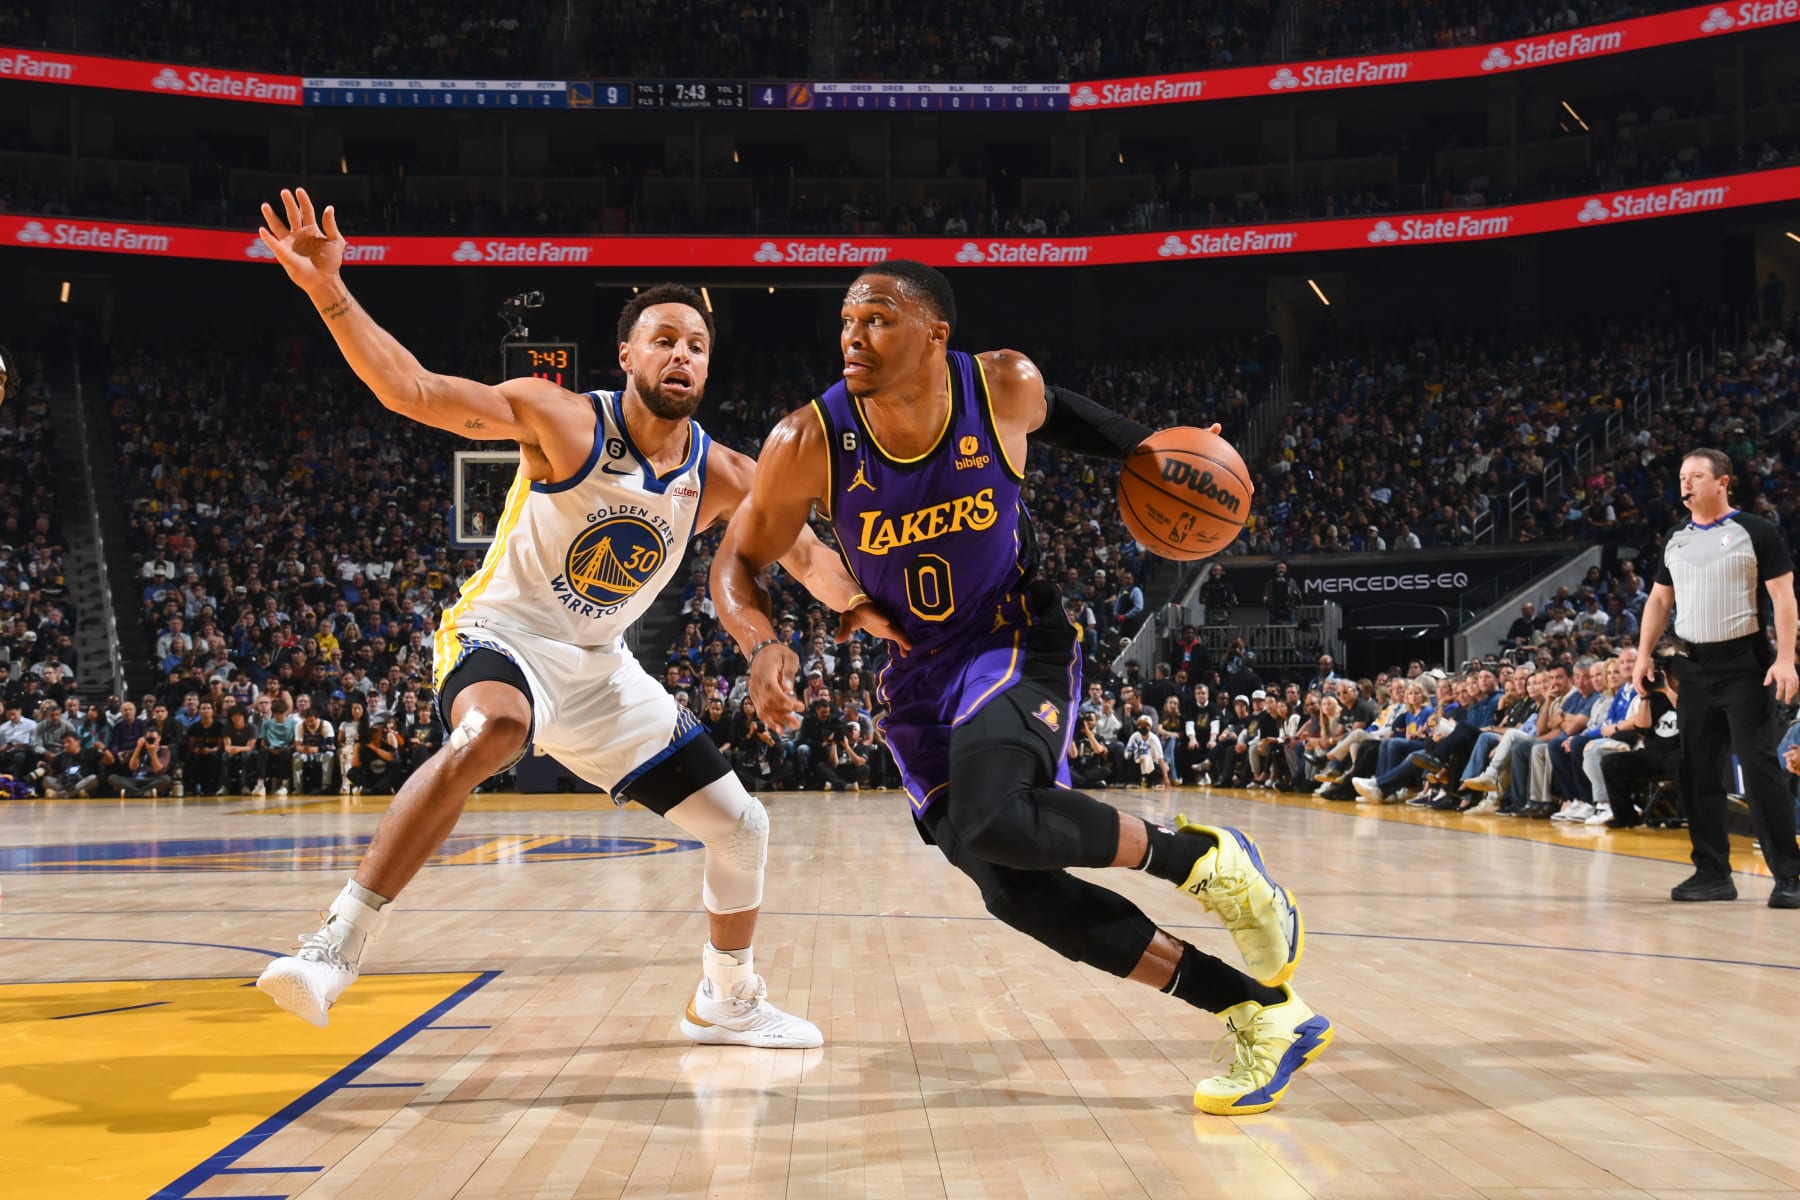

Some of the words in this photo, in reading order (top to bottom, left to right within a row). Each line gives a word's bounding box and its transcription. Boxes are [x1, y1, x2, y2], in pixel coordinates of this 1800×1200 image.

[608, 87, 618, 104] 9
[675, 84, 706, 100] 7:43
[763, 88, 774, 105] 4
[527, 350, 568, 369] 7:43
[609, 441, 623, 458] 6
[843, 432, 857, 450] 6
[955, 454, 990, 471] bibigo
[1162, 457, 1241, 515] Wilson
[586, 504, 649, 524] GOLDEN
[650, 515, 675, 547] STATE
[856, 488, 999, 556] LAKERS
[623, 544, 659, 573] 30
[903, 553, 955, 622] 0
[1304, 571, 1469, 593] MERCEDES-EQ
